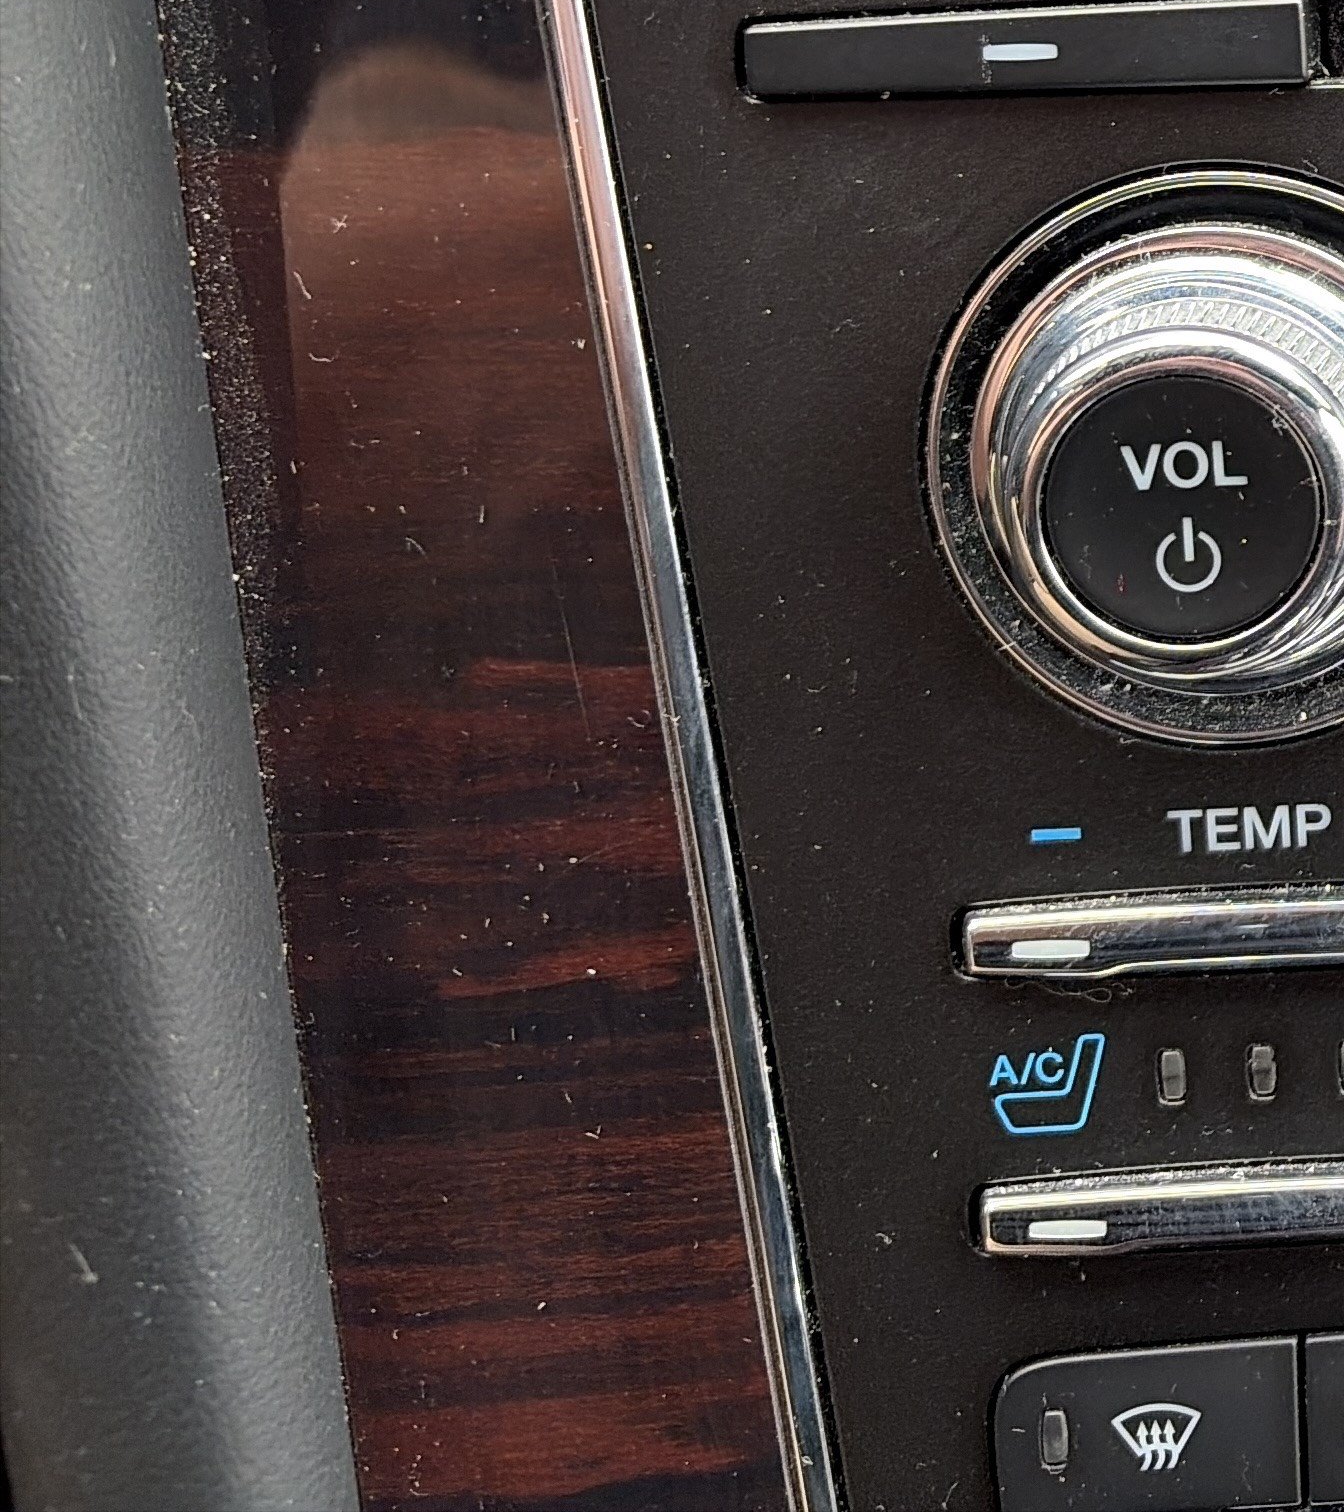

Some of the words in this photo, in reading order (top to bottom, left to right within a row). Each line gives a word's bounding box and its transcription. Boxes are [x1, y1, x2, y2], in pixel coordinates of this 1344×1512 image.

[1119, 439, 1249, 492] VOL
[1166, 802, 1333, 854] TEMP
[988, 1049, 1067, 1088] A/C
